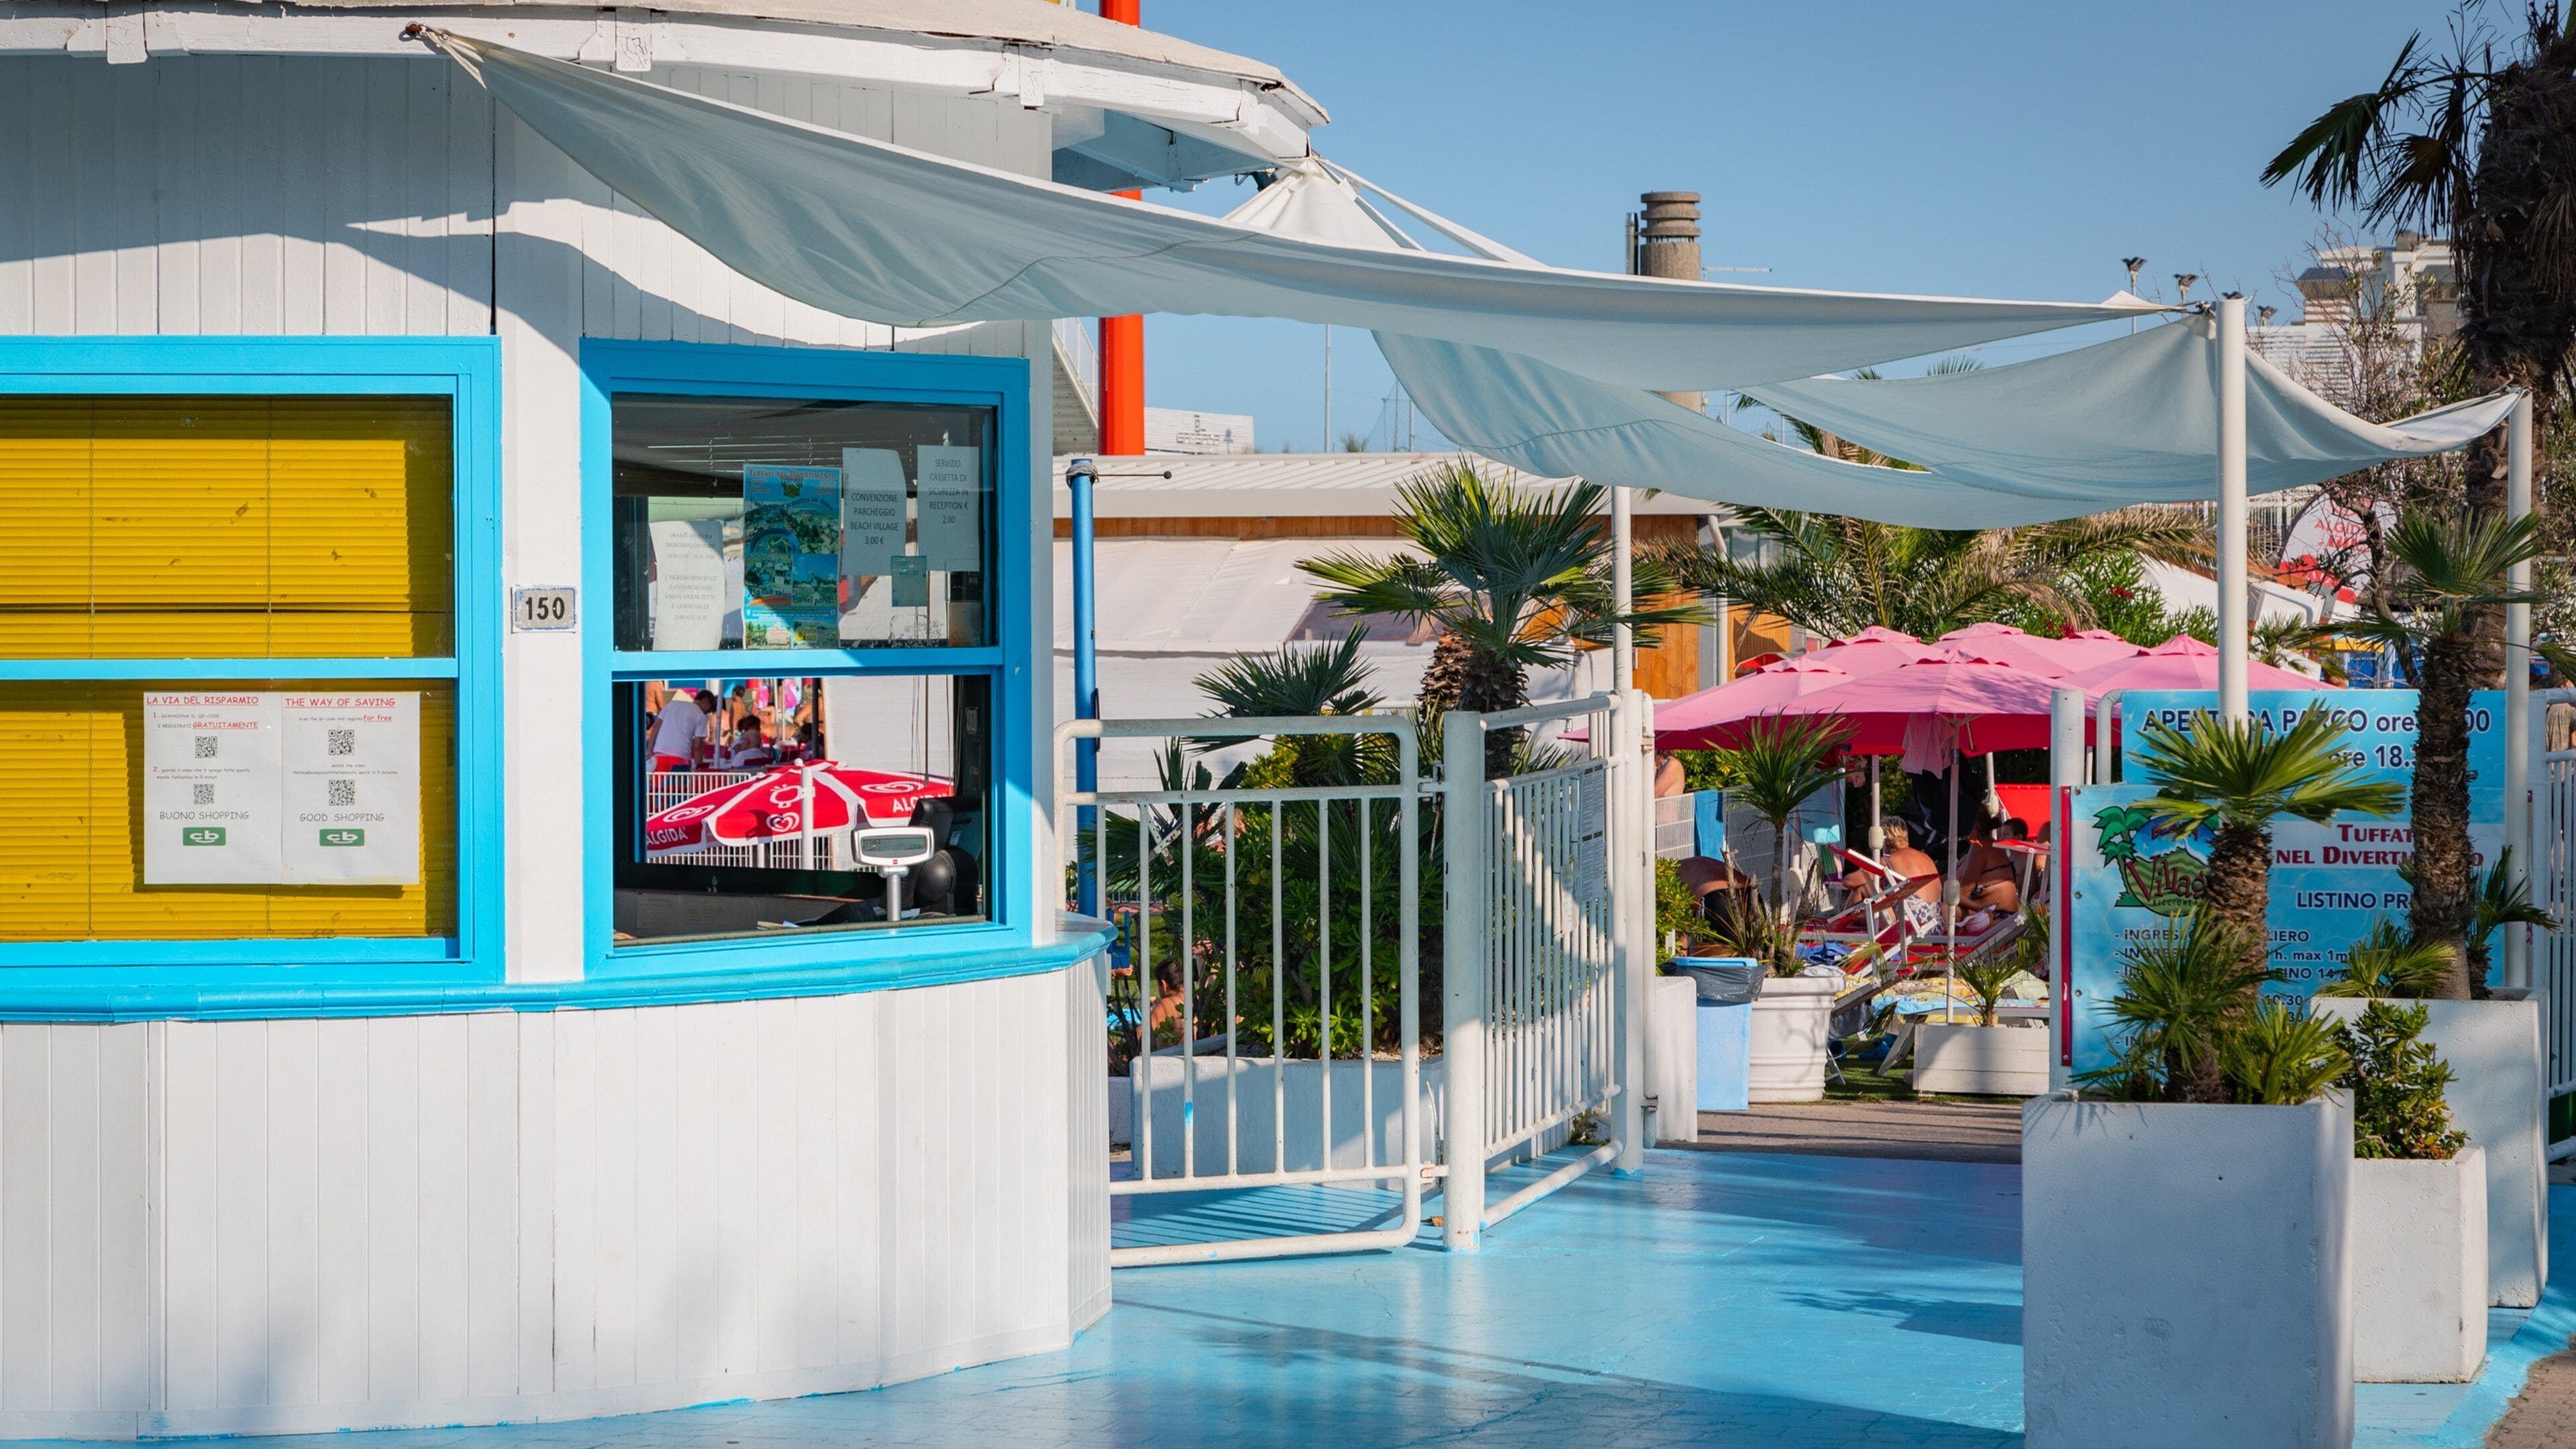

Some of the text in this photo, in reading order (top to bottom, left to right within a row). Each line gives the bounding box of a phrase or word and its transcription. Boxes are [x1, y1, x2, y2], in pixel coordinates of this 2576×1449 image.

[934, 459, 961, 468] SERVIZIO
[929, 473, 967, 482] CASSETTA DI
[928, 487, 969, 496] SICUREZZA IN
[851, 492, 898, 502] CONVENZIONE
[929, 501, 969, 510] RECEPTION €
[853, 507, 896, 517] PARCHEGGIO
[942, 515, 955, 524] 2.00
[850, 521, 899, 531] BEACH VILLAGE
[864, 536, 885, 545] 3,00 €
[525, 596, 565, 621] 150
[146, 696, 259, 704] LA VIA DEL RISPARMIO
[285, 698, 396, 706] THE WAY OF SAVING
[193, 721, 258, 729] GRATUITAMENTE
[2376, 715, 2414, 732] ore
[160, 811, 250, 820] BUONO SHOPPING
[299, 813, 385, 822] GOOD SHOPPING
[2337, 823, 2413, 843] TUFFAT
[2276, 849, 2315, 864] NEL
[2125, 854, 2208, 902] Villag
[2297, 892, 2377, 909] LISTINO
[2293, 952, 2322, 961] max
